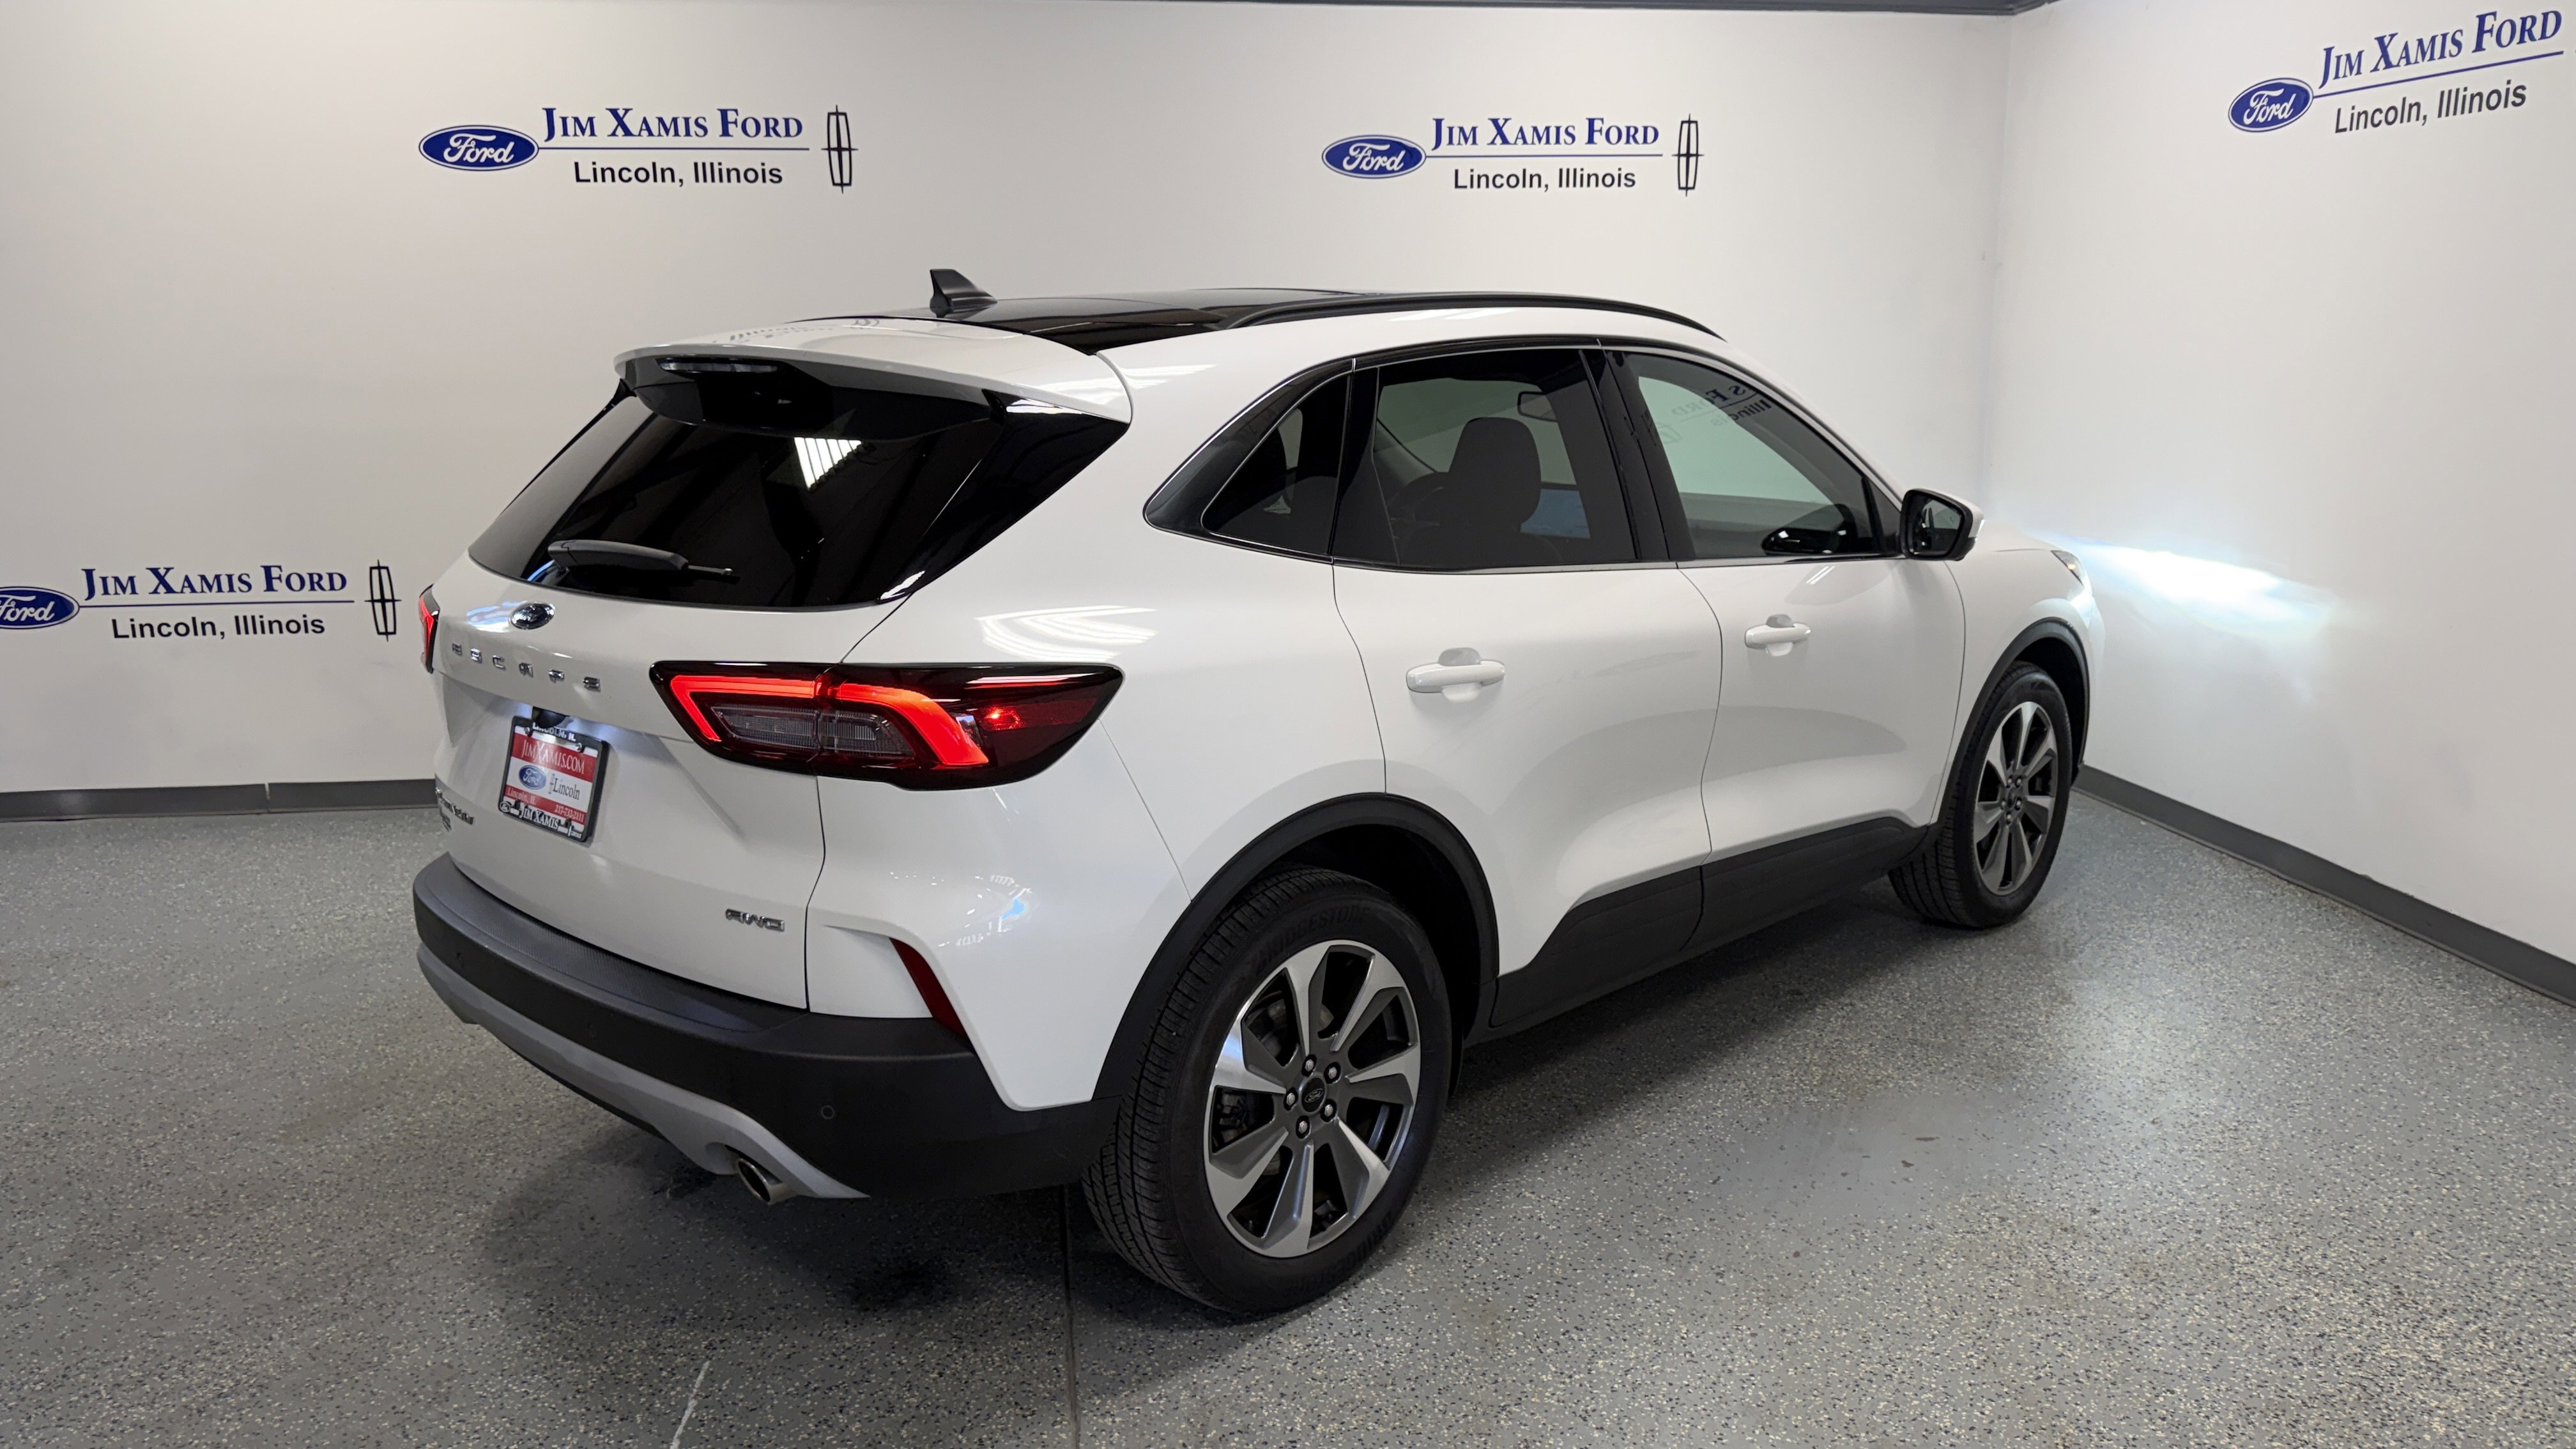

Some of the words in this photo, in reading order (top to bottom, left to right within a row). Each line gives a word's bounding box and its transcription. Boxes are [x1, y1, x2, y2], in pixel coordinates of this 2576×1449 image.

[2318, 46, 2364, 89] JIM
[2370, 29, 2463, 74] XAMIS
[2472, 10, 2562, 53] FORD
[2243, 88, 2296, 125] Ford
[2334, 96, 2427, 134] Lincoln,
[2437, 79, 2527, 118] Illinois
[542, 108, 598, 142] JIM
[605, 108, 709, 138] XAMIS
[716, 109, 803, 138] FORD
[1432, 118, 1478, 151] JIM
[1487, 118, 1576, 146] XAMIS
[1584, 118, 1659, 146] FORD
[443, 132, 514, 164] Ford
[1342, 142, 1404, 172] Ford
[574, 161, 684, 188] Lincoln,
[694, 161, 783, 184] Illinois
[1454, 169, 1549, 192] Lincoln,
[1558, 168, 1636, 188] Illinois
[81, 568, 139, 601] JIM
[146, 567, 252, 595] XAMIS
[261, 565, 348, 592] FORD
[111, 616, 225, 640] Lincoln,
[234, 613, 325, 636] Illinois
[452, 642, 601, 691] ESCAPE
[553, 778, 580, 800] Lincoln
